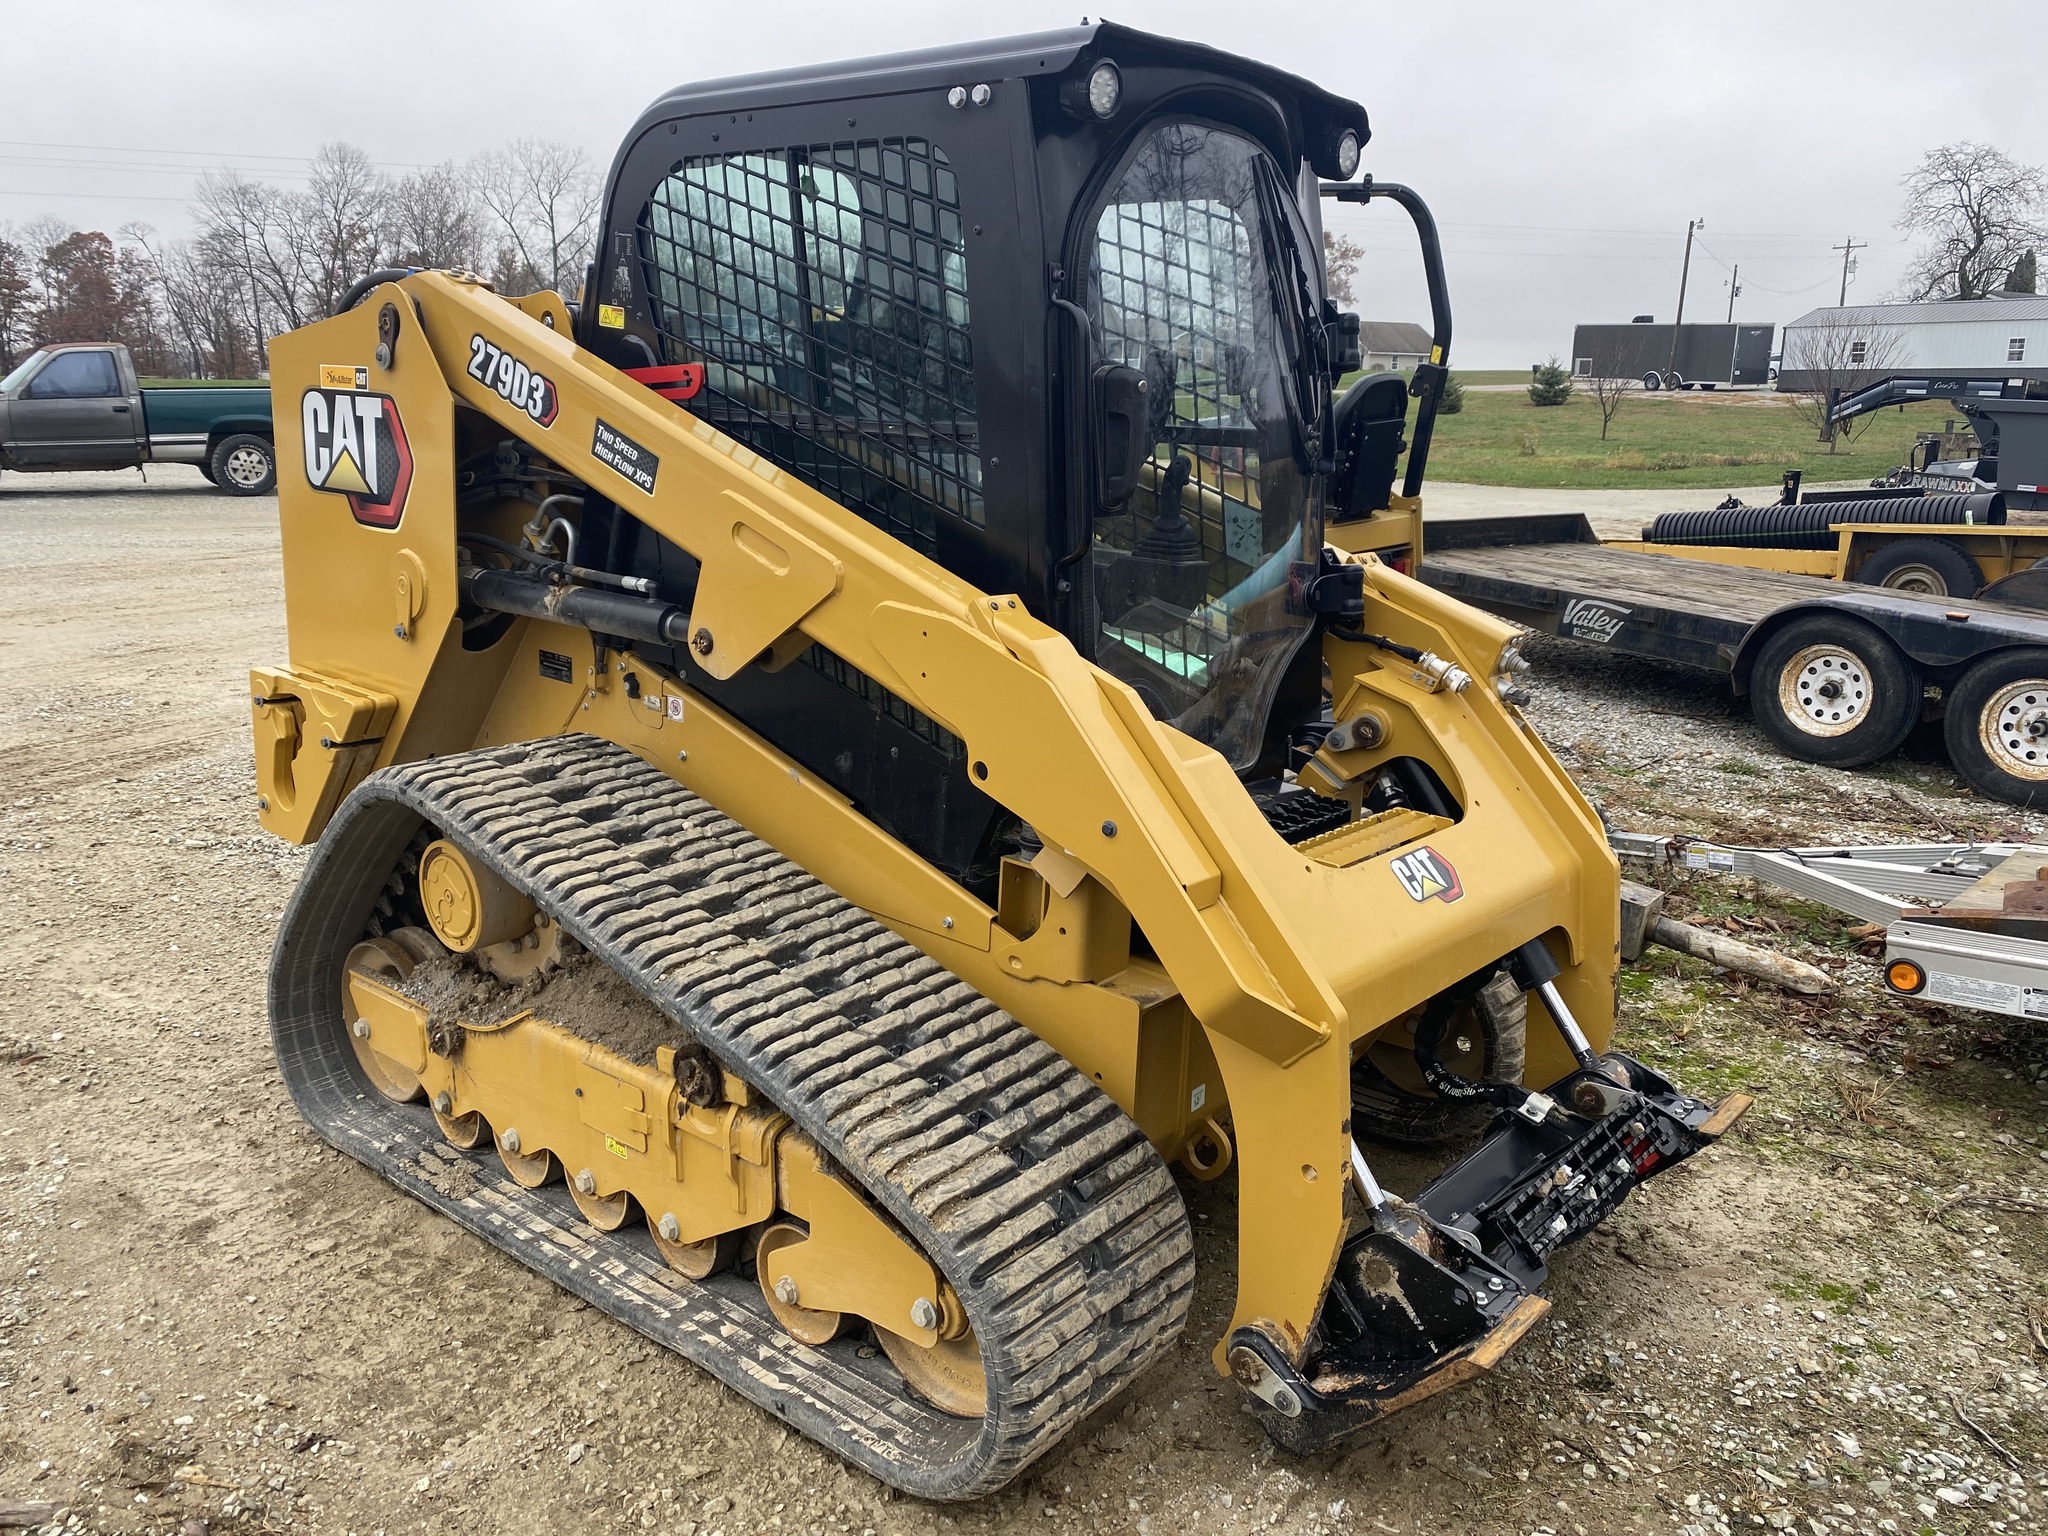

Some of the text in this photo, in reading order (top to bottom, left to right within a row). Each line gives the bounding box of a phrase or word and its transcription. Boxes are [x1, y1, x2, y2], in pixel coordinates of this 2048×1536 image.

[355, 372, 367, 386] CAT
[468, 335, 545, 418] 279D3
[303, 391, 382, 495] CAT
[594, 441, 653, 489] HIGH FLOW XPS
[597, 425, 638, 461] TWO SPEED
[1563, 598, 1632, 639] Valley
[1575, 628, 1607, 642] TRILERS
[1391, 848, 1448, 901] CAT
